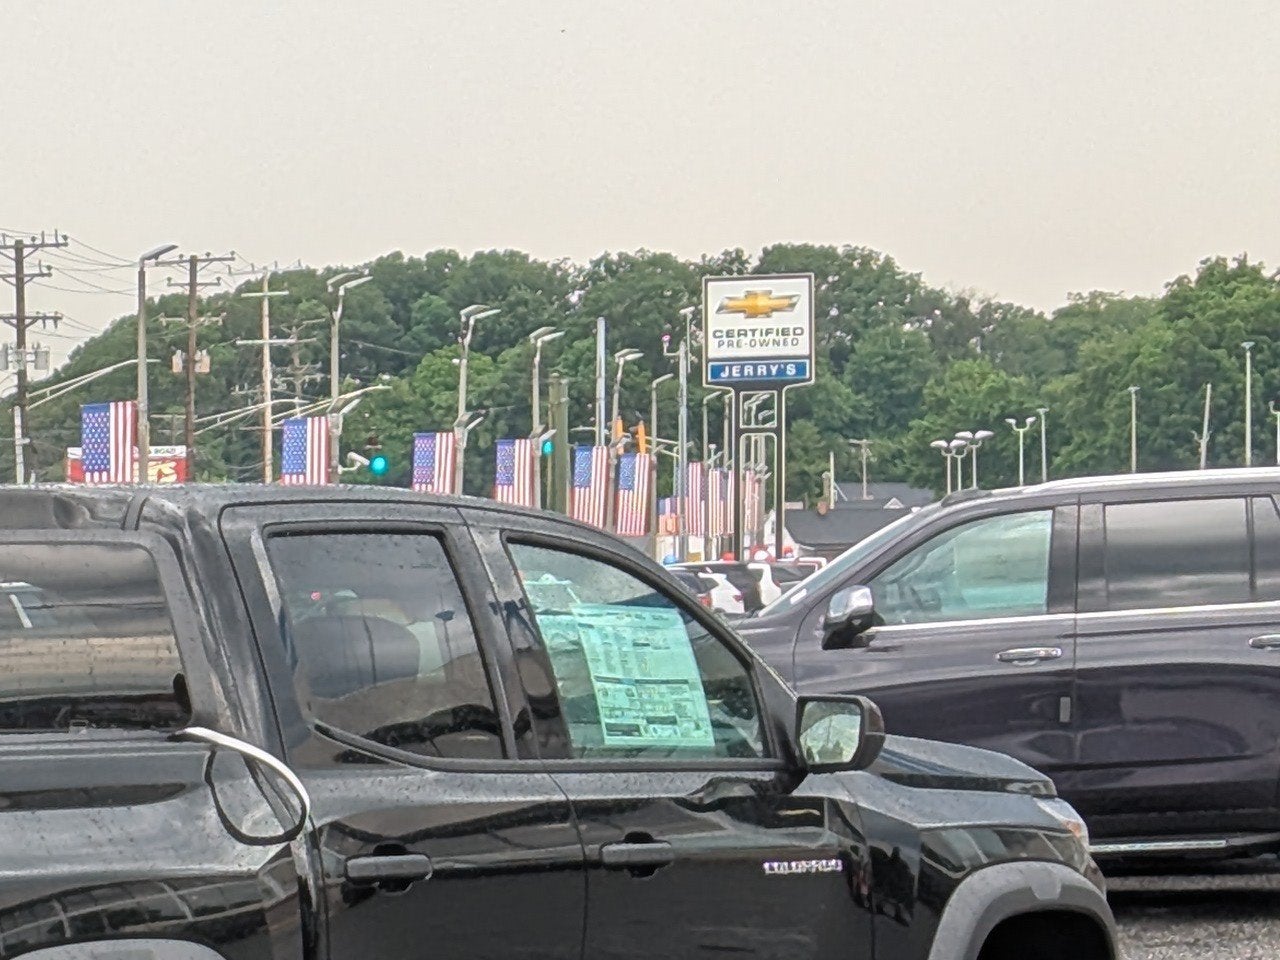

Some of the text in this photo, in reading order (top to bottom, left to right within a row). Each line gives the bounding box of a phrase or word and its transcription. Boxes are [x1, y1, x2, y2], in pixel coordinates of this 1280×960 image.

[713, 327, 805, 339] CERTIFIED
[718, 338, 799, 349] PRE-OWNED
[720, 364, 796, 378] JERRY'S
